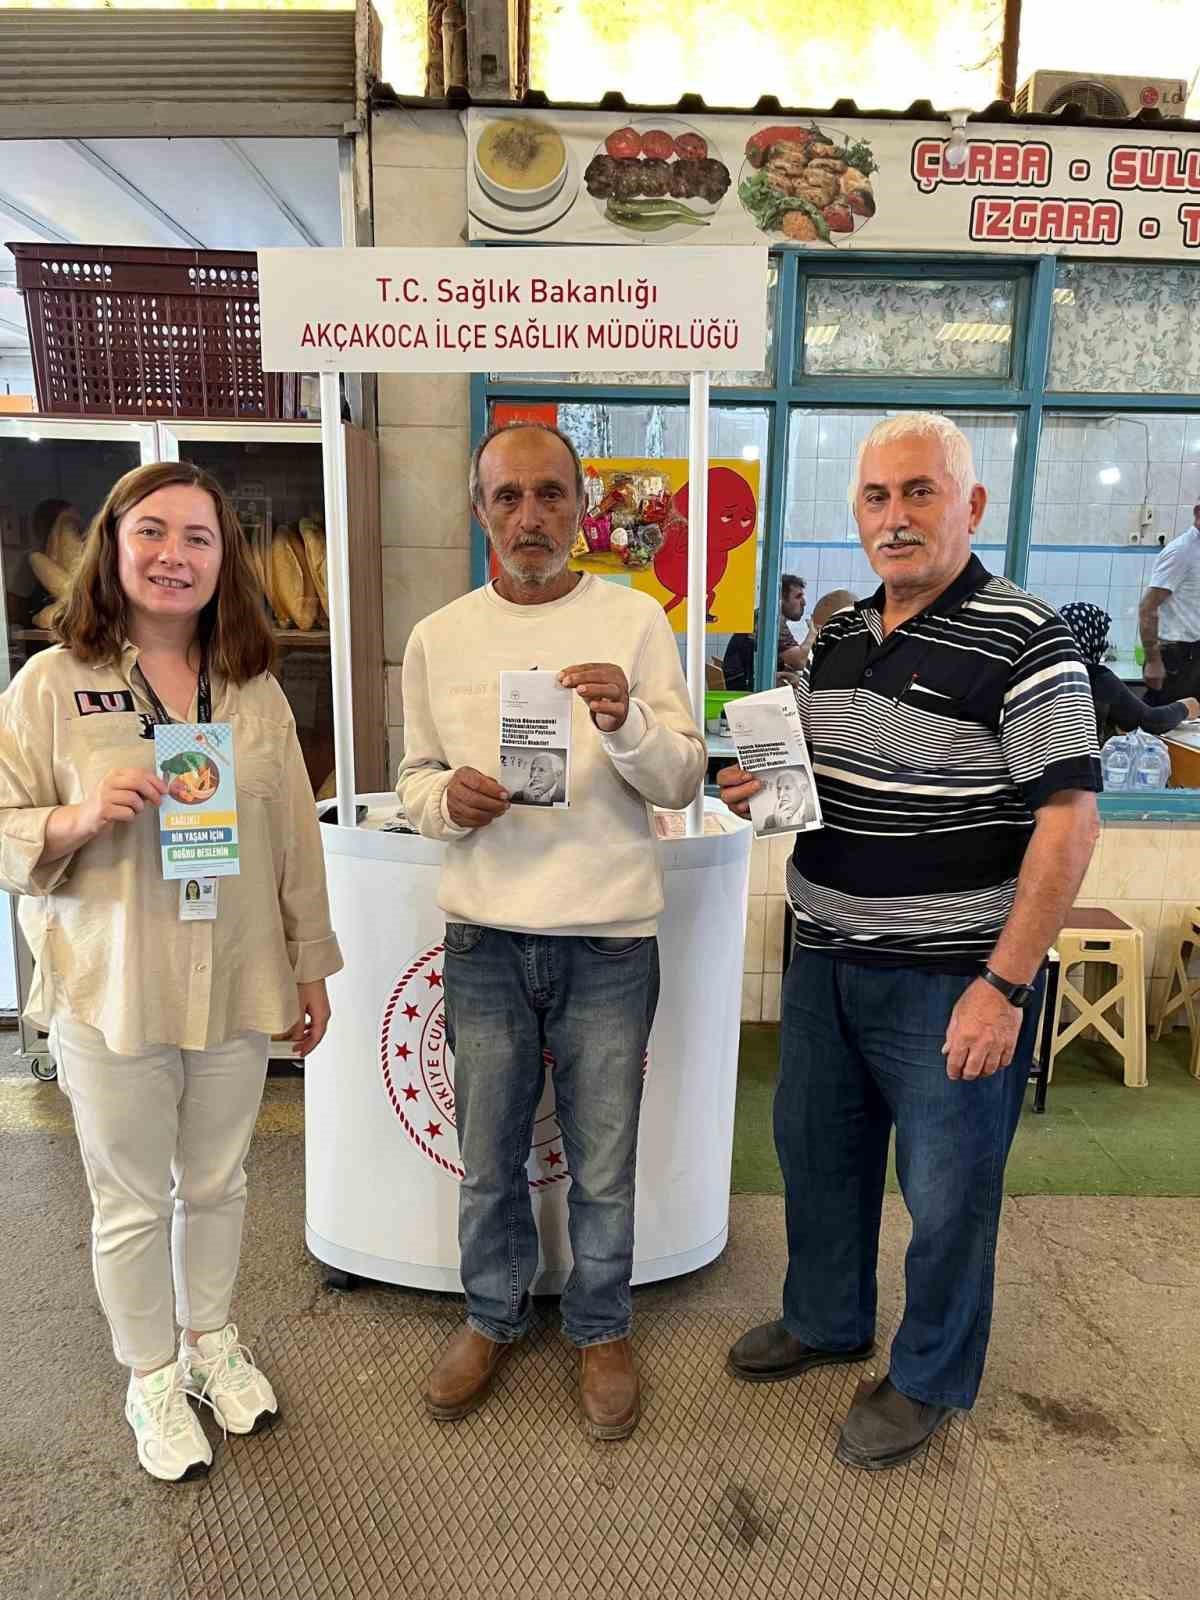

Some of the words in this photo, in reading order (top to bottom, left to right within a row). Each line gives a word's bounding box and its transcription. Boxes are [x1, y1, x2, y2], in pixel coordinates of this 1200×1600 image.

[971, 197, 1120, 242] IZGARA
[1180, 205, 1200, 245] T
[376, 277, 428, 303] T.C.
[437, 277, 521, 309] Sağlık
[531, 277, 657, 309] Bakanlığı
[300, 322, 429, 352] AKÇAKOCA
[436, 318, 487, 352] İLÇE
[494, 318, 580, 349] SAĞLIK
[587, 318, 739, 349] MÜDÜRLÜĞÜ
[184, 831, 208, 843] YAŞAM
[427, 1059, 456, 1122] RKİYE
